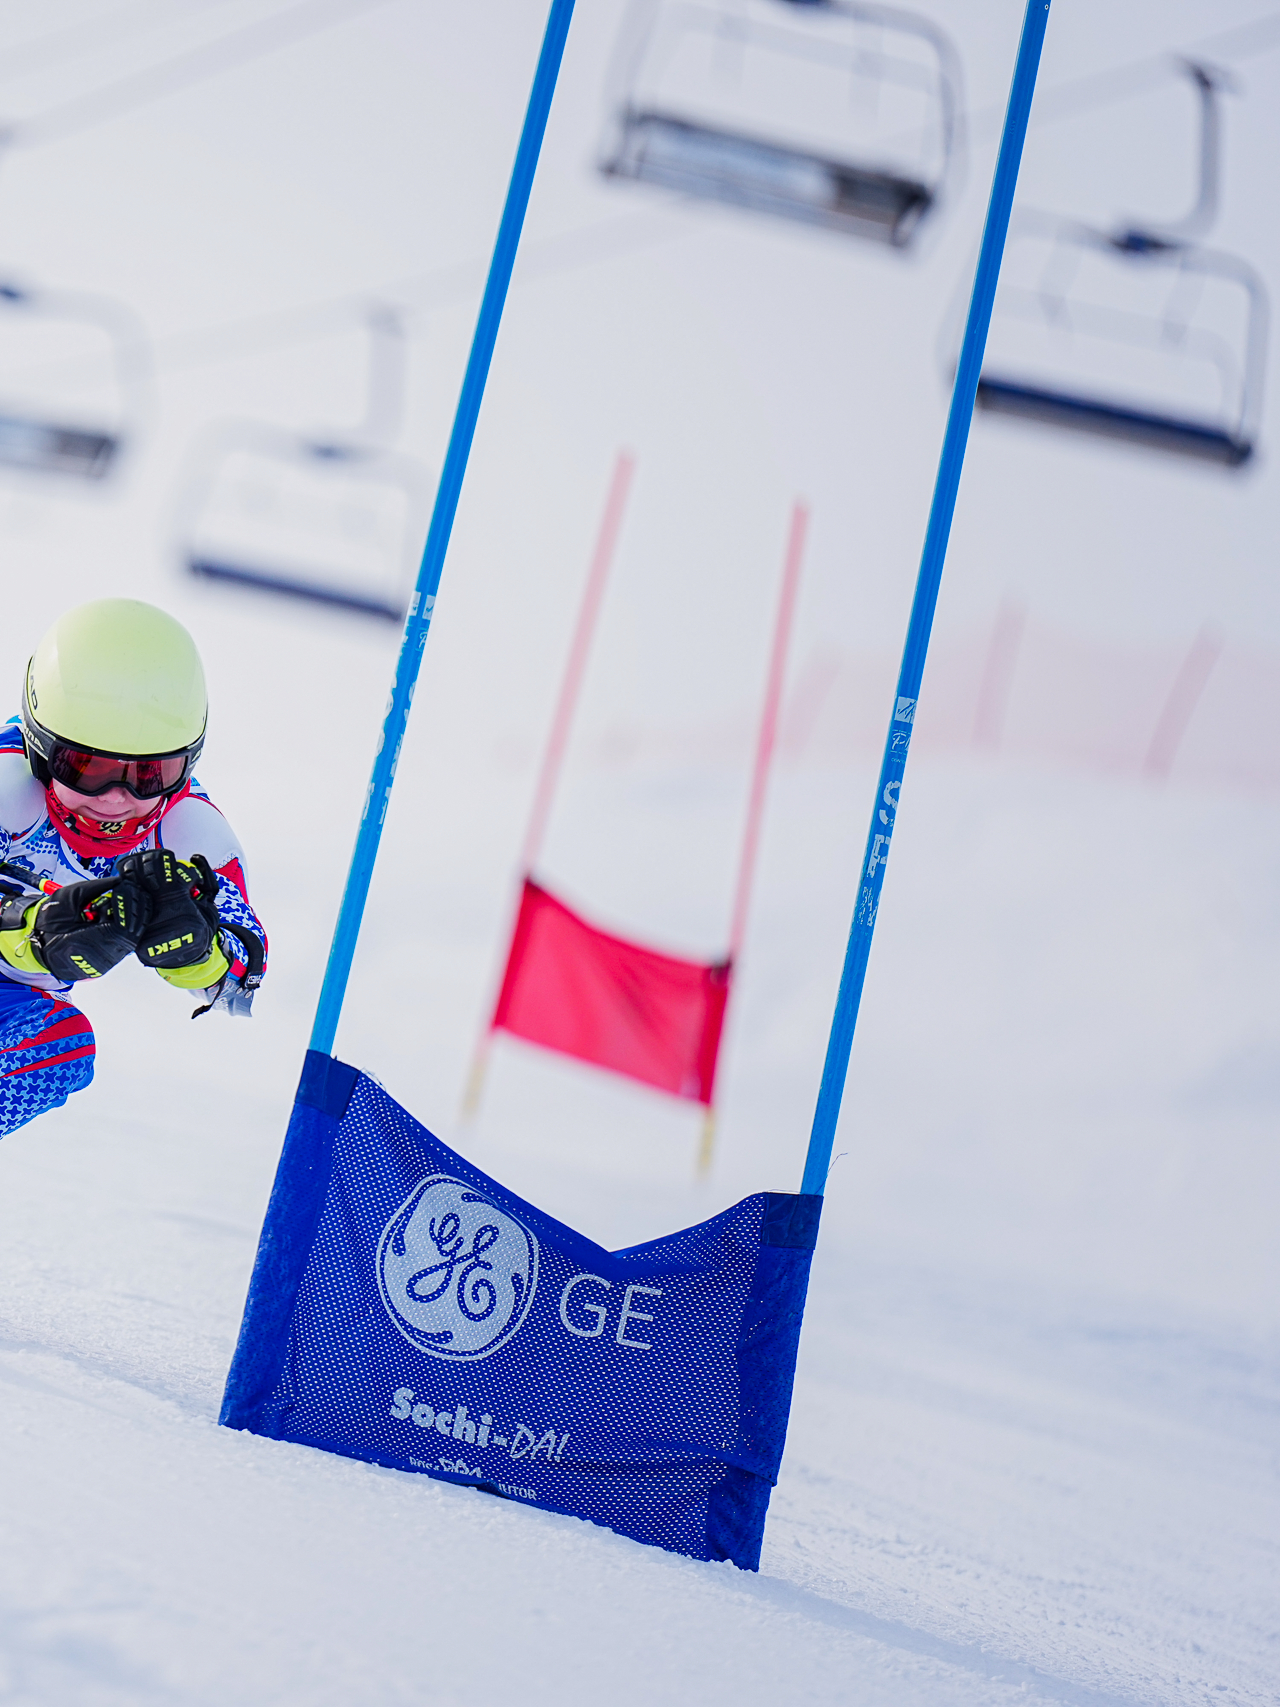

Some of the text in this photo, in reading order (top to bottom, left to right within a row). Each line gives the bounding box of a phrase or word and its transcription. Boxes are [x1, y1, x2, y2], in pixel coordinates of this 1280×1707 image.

[163, 855, 172, 882] LEKI
[176, 868, 191, 882] EKI
[117, 895, 125, 926] LEKI
[147, 933, 194, 957] LEKI
[70, 955, 102, 978] LEKI
[558, 1273, 662, 1351] GE
[498, 1483, 538, 1501] UTOR
